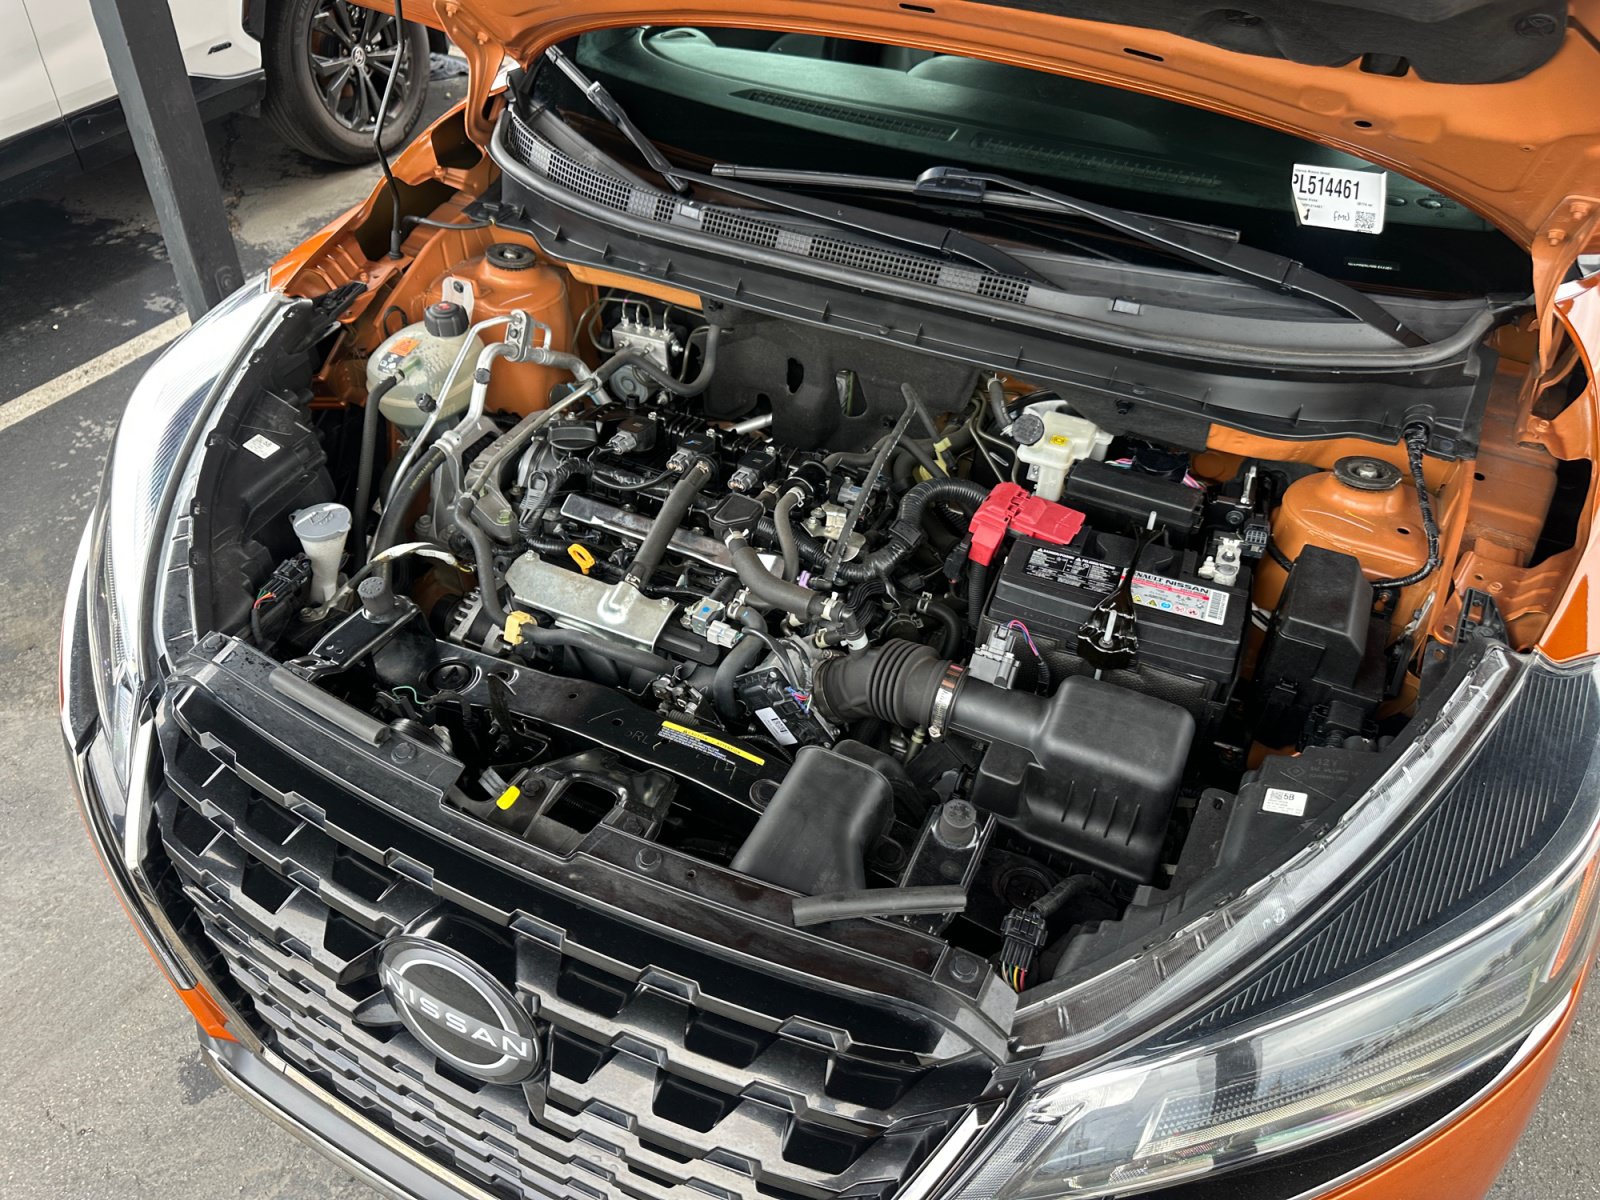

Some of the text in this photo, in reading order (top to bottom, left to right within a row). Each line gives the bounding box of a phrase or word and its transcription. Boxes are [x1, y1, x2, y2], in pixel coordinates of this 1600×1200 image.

[1134, 571, 1209, 594] NAULT NISSAN
[385, 969, 527, 1058] NISSAN
